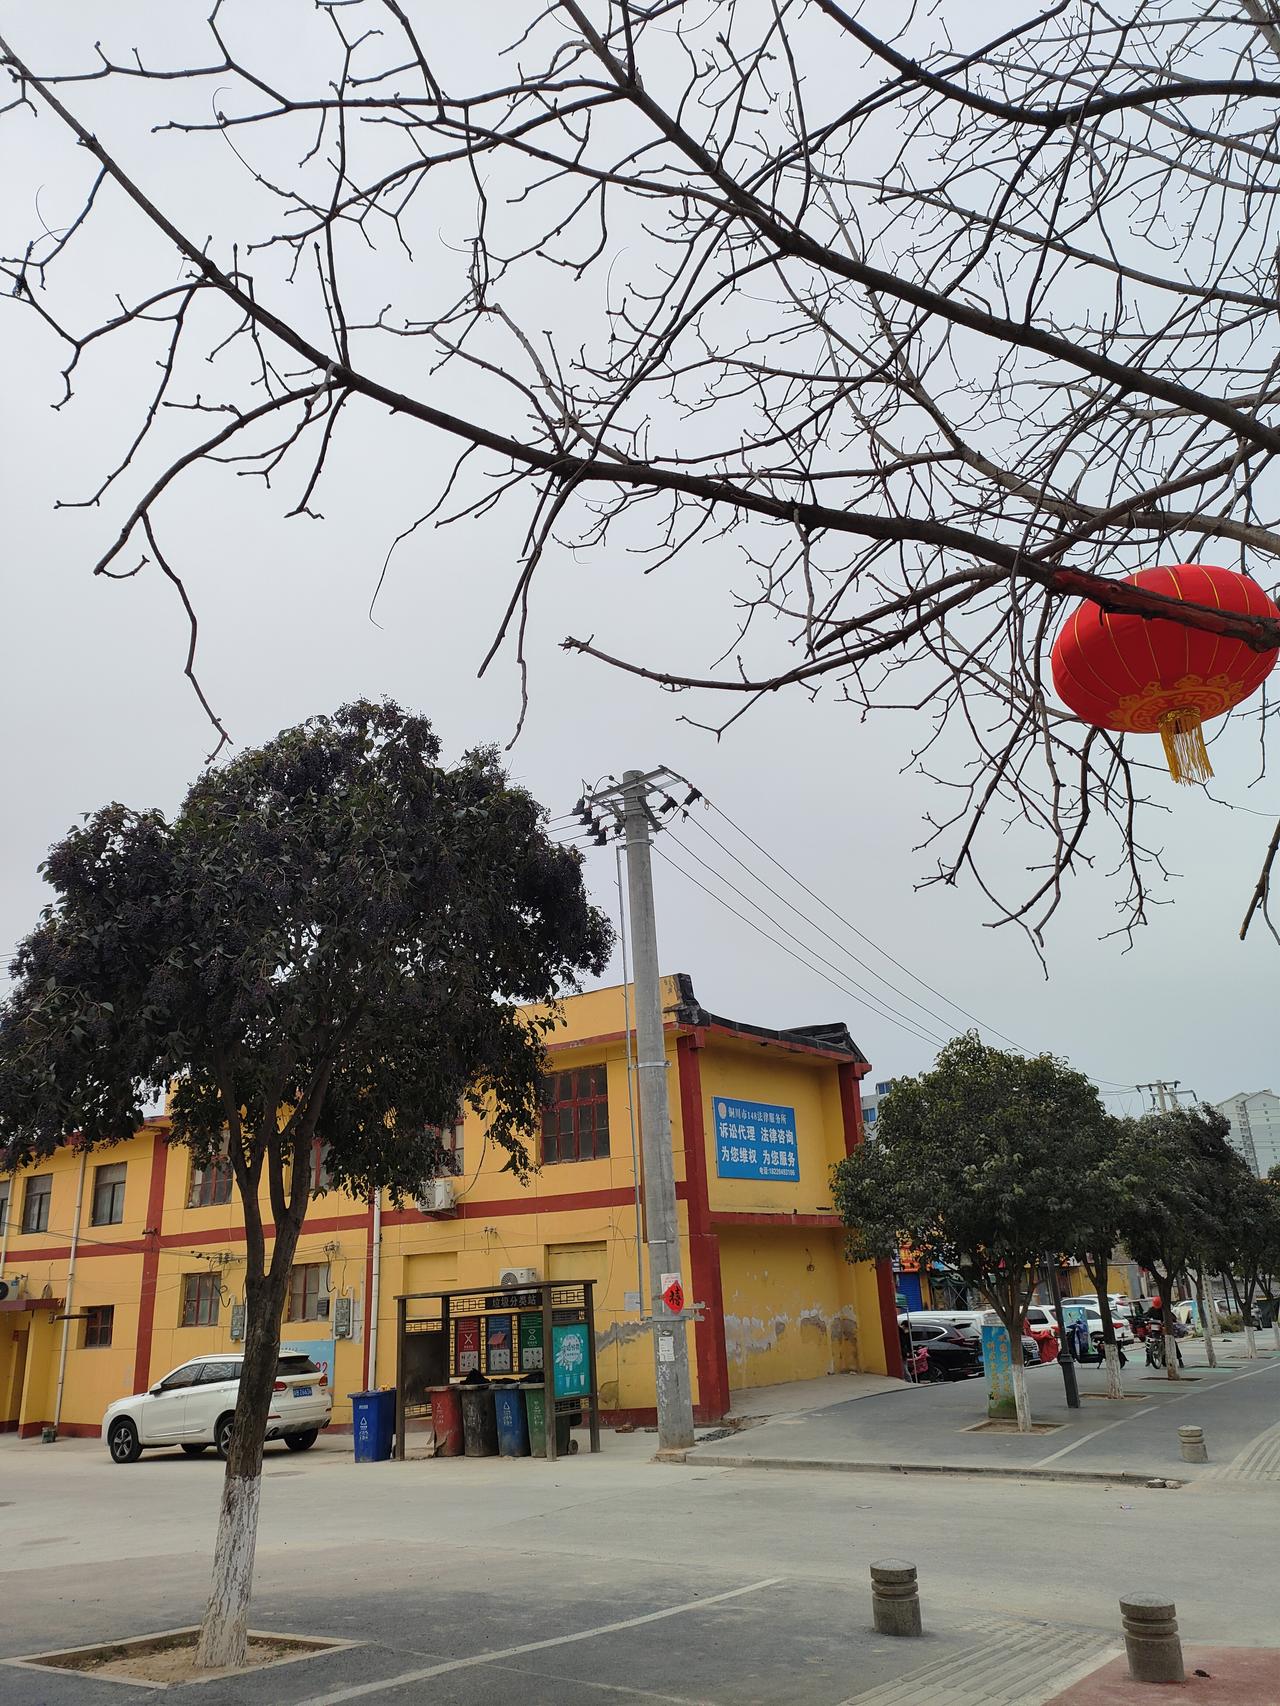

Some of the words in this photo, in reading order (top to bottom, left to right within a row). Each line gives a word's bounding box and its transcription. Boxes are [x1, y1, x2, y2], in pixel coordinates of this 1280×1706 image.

[728, 1106, 787, 1125] 铜川市148法律服务所
[719, 1122, 756, 1141] 诉讼代理
[760, 1127, 794, 1145] 法律咨询
[721, 1146, 757, 1163] 为您维权
[763, 1149, 796, 1167] 为您服务
[492, 1294, 537, 1307] 垃圾分类站
